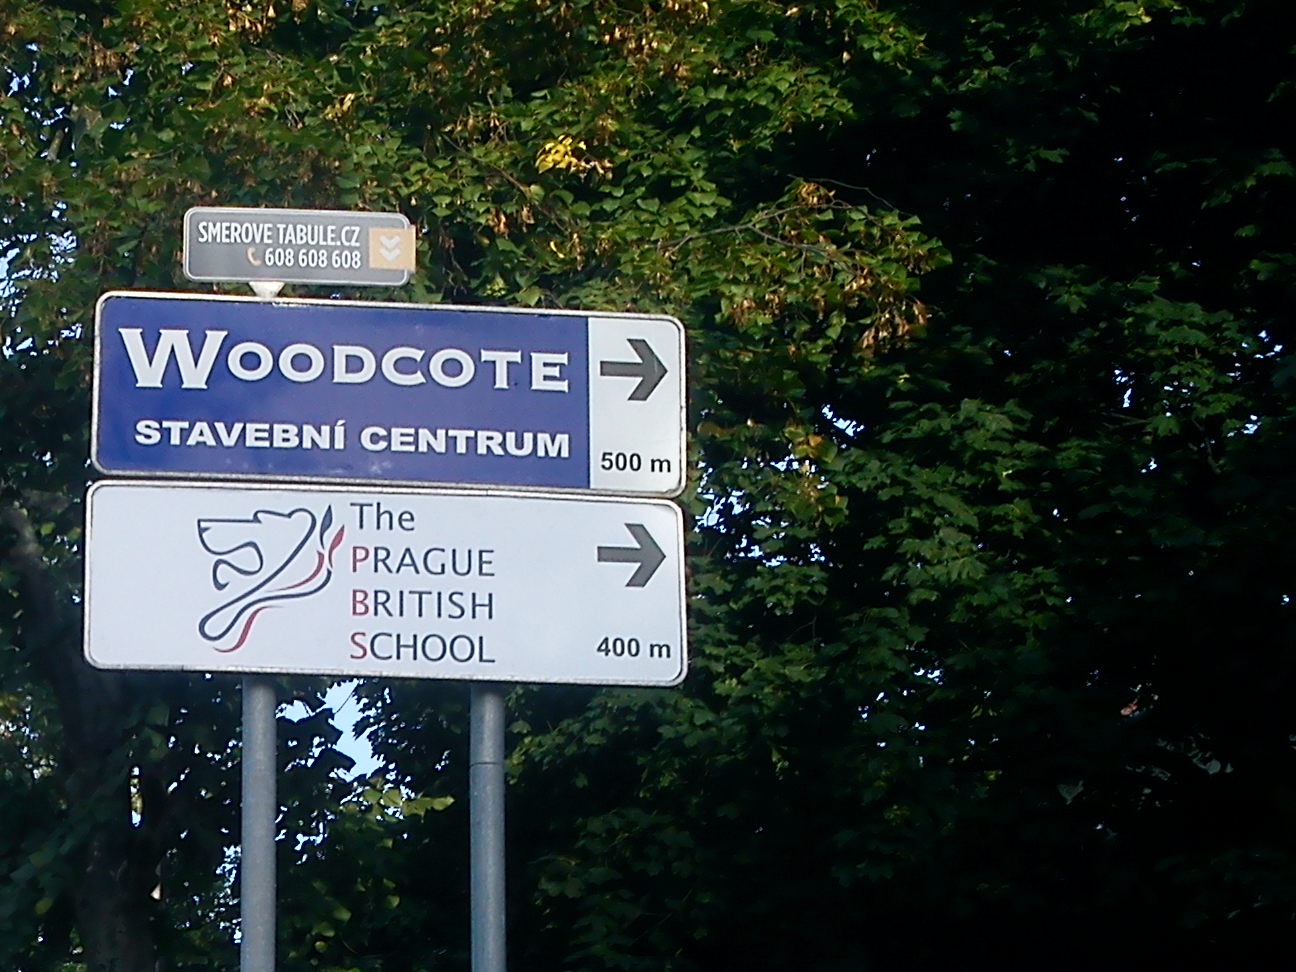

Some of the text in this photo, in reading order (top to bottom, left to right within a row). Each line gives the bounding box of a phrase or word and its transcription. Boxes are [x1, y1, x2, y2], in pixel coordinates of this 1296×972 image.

[198, 221, 360, 247] SMEROVE TABULE.CZ
[265, 248, 361, 269] 608 608 608
[118, 327, 570, 393] WOODCOTE
[134, 419, 570, 458] STAVEBNÍ CENTRUM
[601, 451, 672, 473] 500 m
[350, 502, 415, 531] The
[352, 546, 495, 577] PRAGUE
[352, 589, 494, 620] BRITISH
[350, 632, 496, 664] SCHOOL
[596, 638, 672, 659] 400 m
